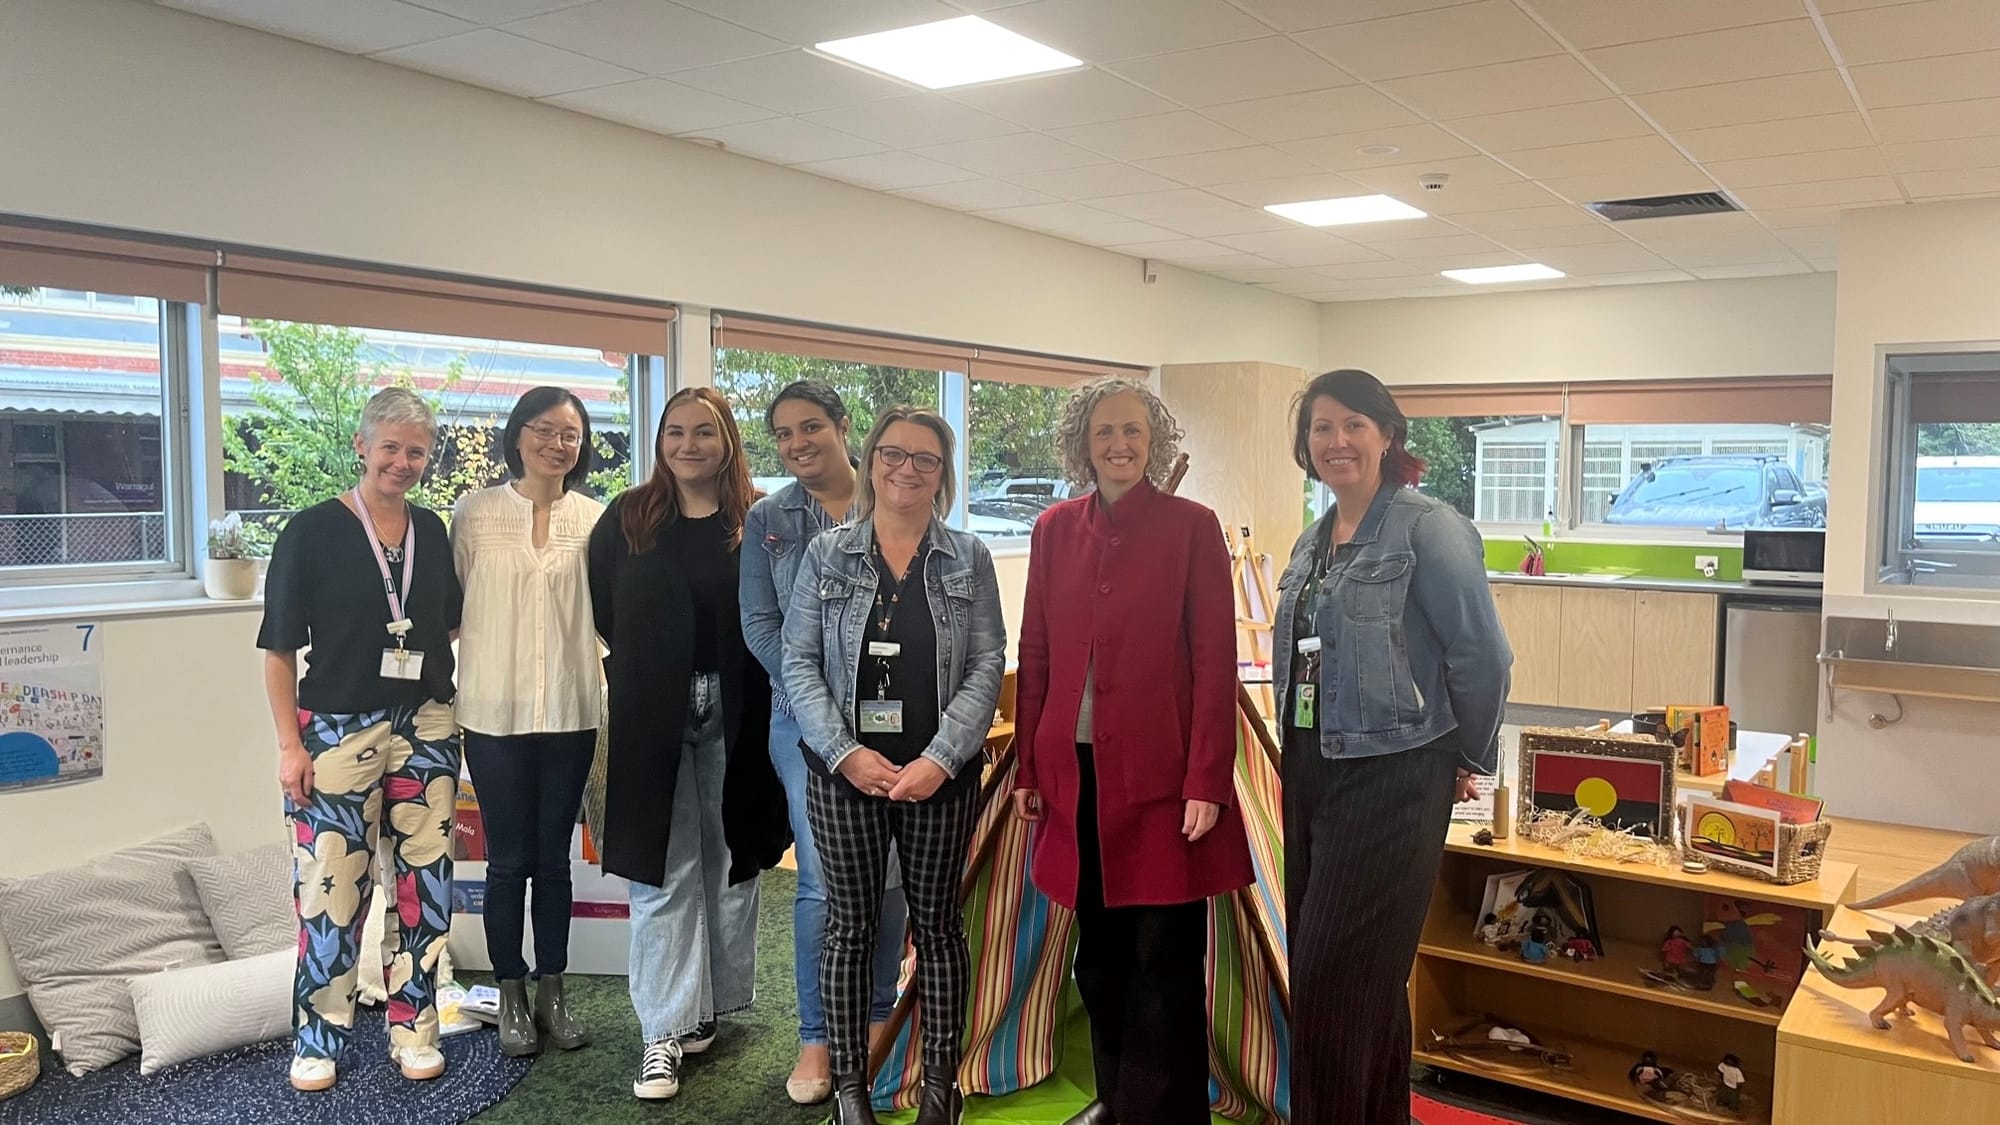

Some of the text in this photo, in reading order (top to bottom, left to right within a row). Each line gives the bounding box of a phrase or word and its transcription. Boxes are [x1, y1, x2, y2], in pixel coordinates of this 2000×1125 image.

[115, 482, 154, 492] Warragul
[76, 624, 94, 651] 7
[4, 653, 59, 666] leadership
